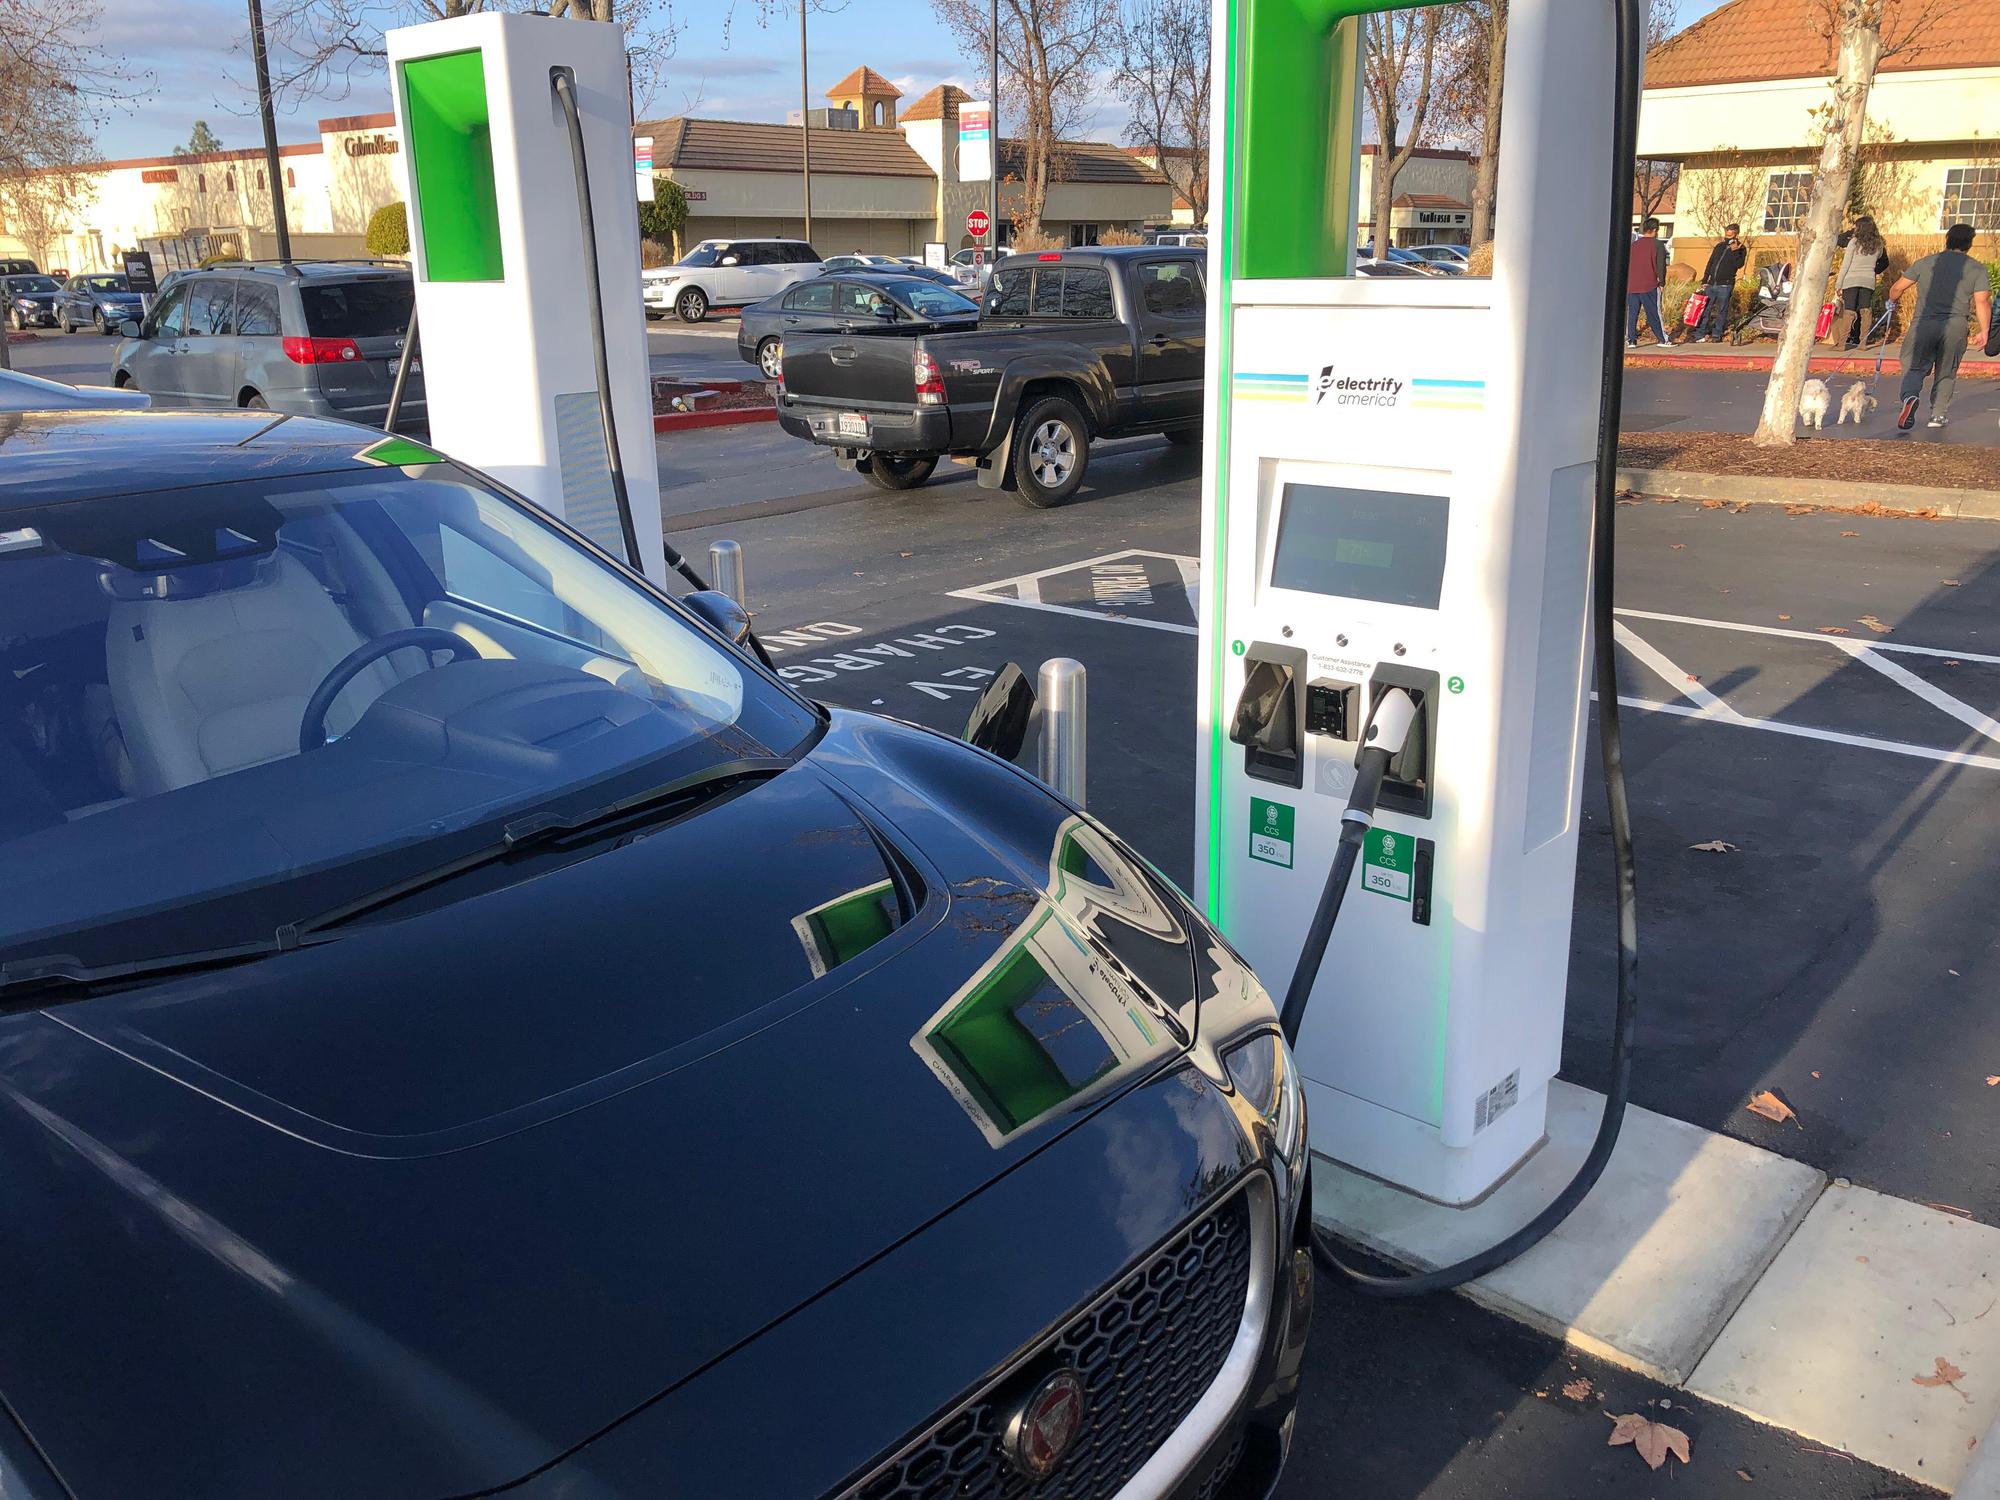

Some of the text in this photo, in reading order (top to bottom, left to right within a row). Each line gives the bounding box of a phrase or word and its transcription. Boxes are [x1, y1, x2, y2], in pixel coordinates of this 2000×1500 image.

[968, 218, 989, 229] STOP
[950, 360, 981, 372] TRD
[972, 367, 995, 375] SPORT
[1336, 376, 1403, 395] electrify
[1337, 393, 1397, 407] america
[1091, 576, 1155, 606] PARKING
[779, 624, 997, 689] CHARG
[1311, 653, 1371, 668] Customer Assistance
[1451, 679, 1461, 692] 2
[1264, 825, 1280, 837] CCS
[1257, 843, 1275, 856] 350
[1379, 856, 1397, 867] CCS
[1371, 875, 1392, 888] 350
